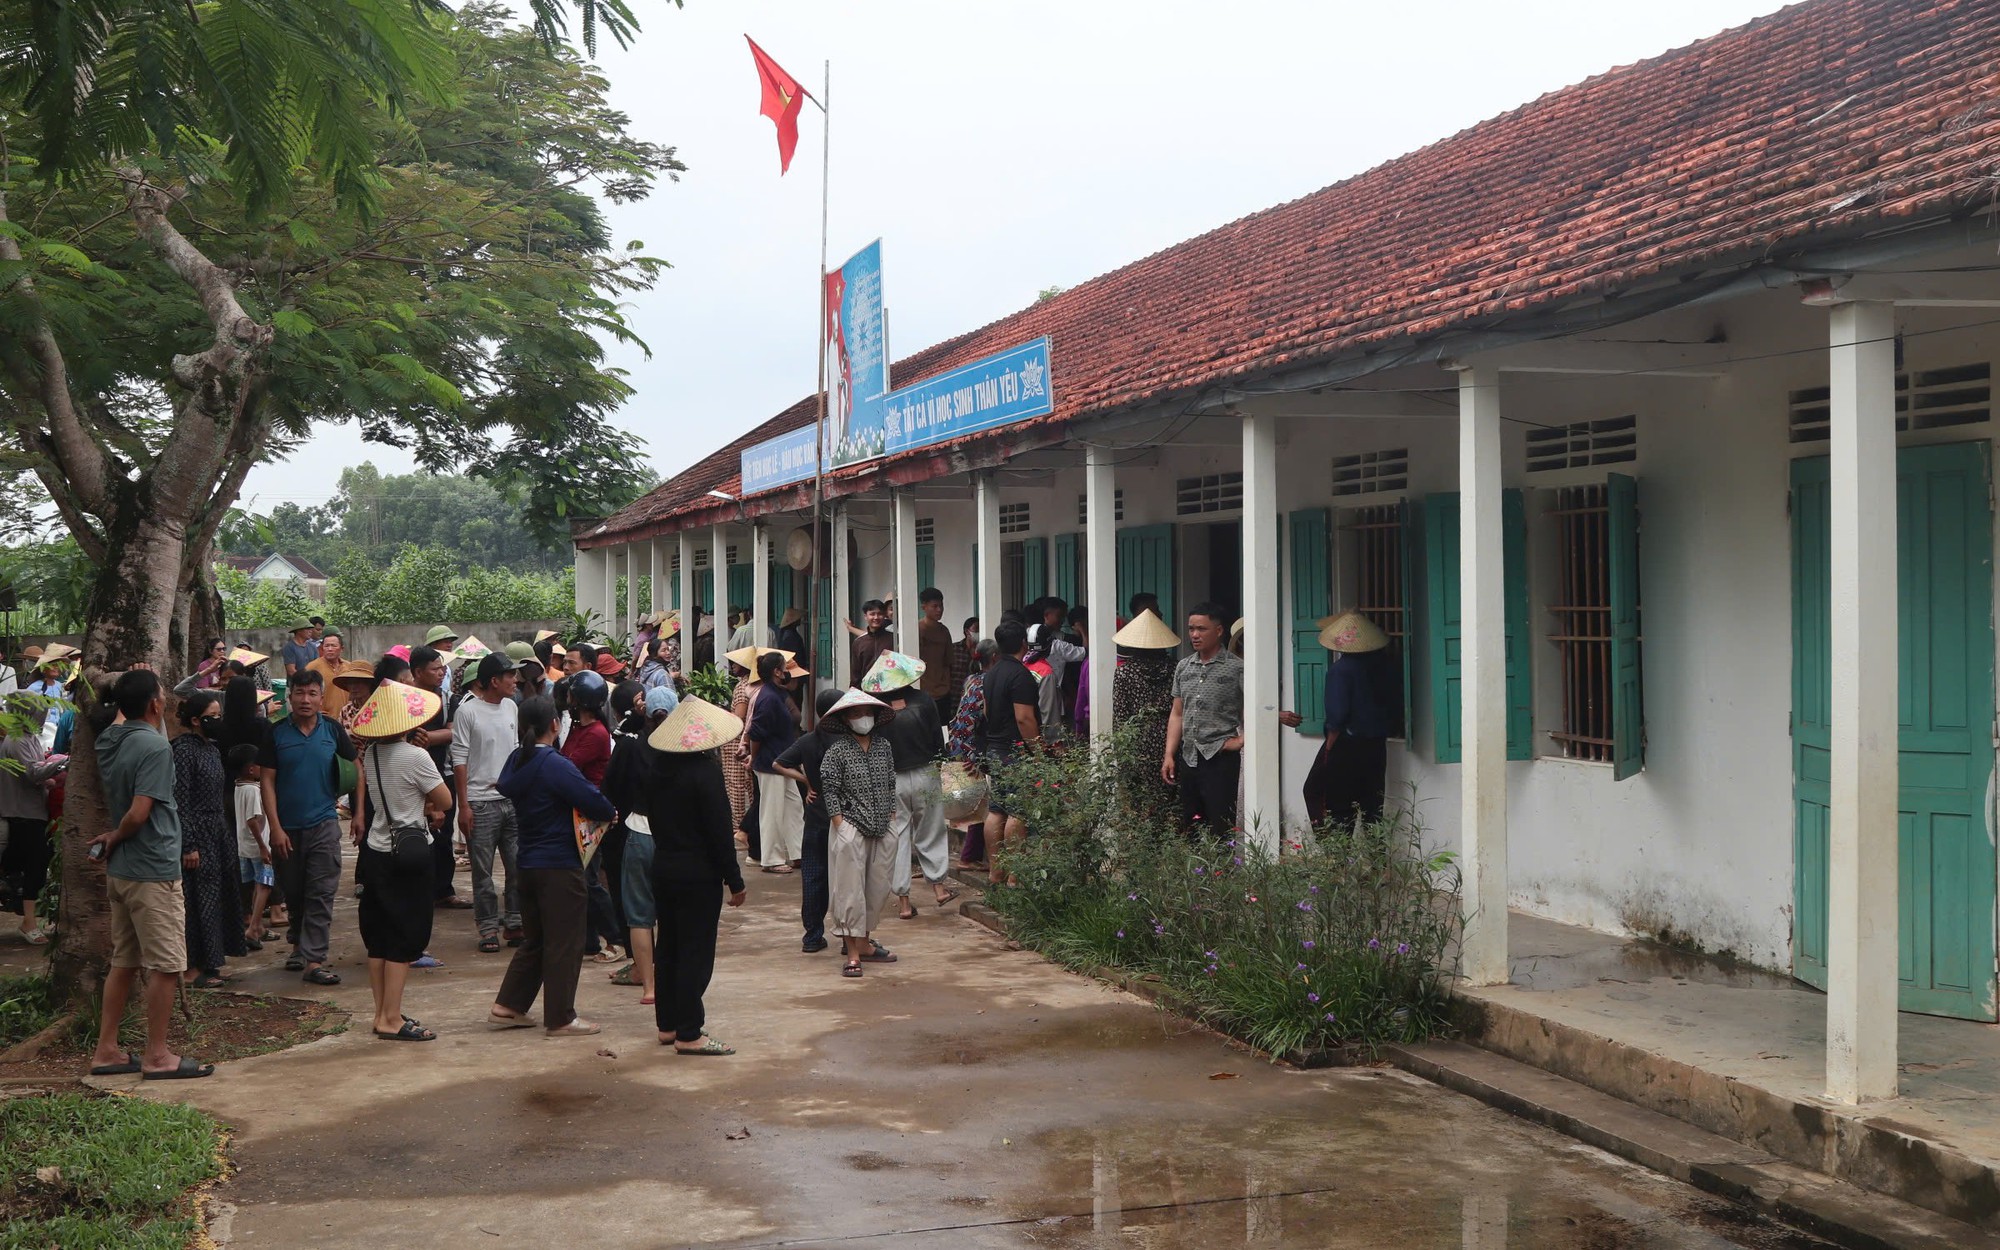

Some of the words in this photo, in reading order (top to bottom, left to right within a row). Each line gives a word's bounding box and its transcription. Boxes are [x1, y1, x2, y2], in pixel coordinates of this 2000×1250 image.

[903, 397, 914, 432] TẤT
[927, 393, 935, 426] VÌ
[936, 393, 952, 428] HỌC
[954, 386, 973, 418] SINH
[975, 374, 998, 411] THÂN
[999, 368, 1018, 404] YÊU
